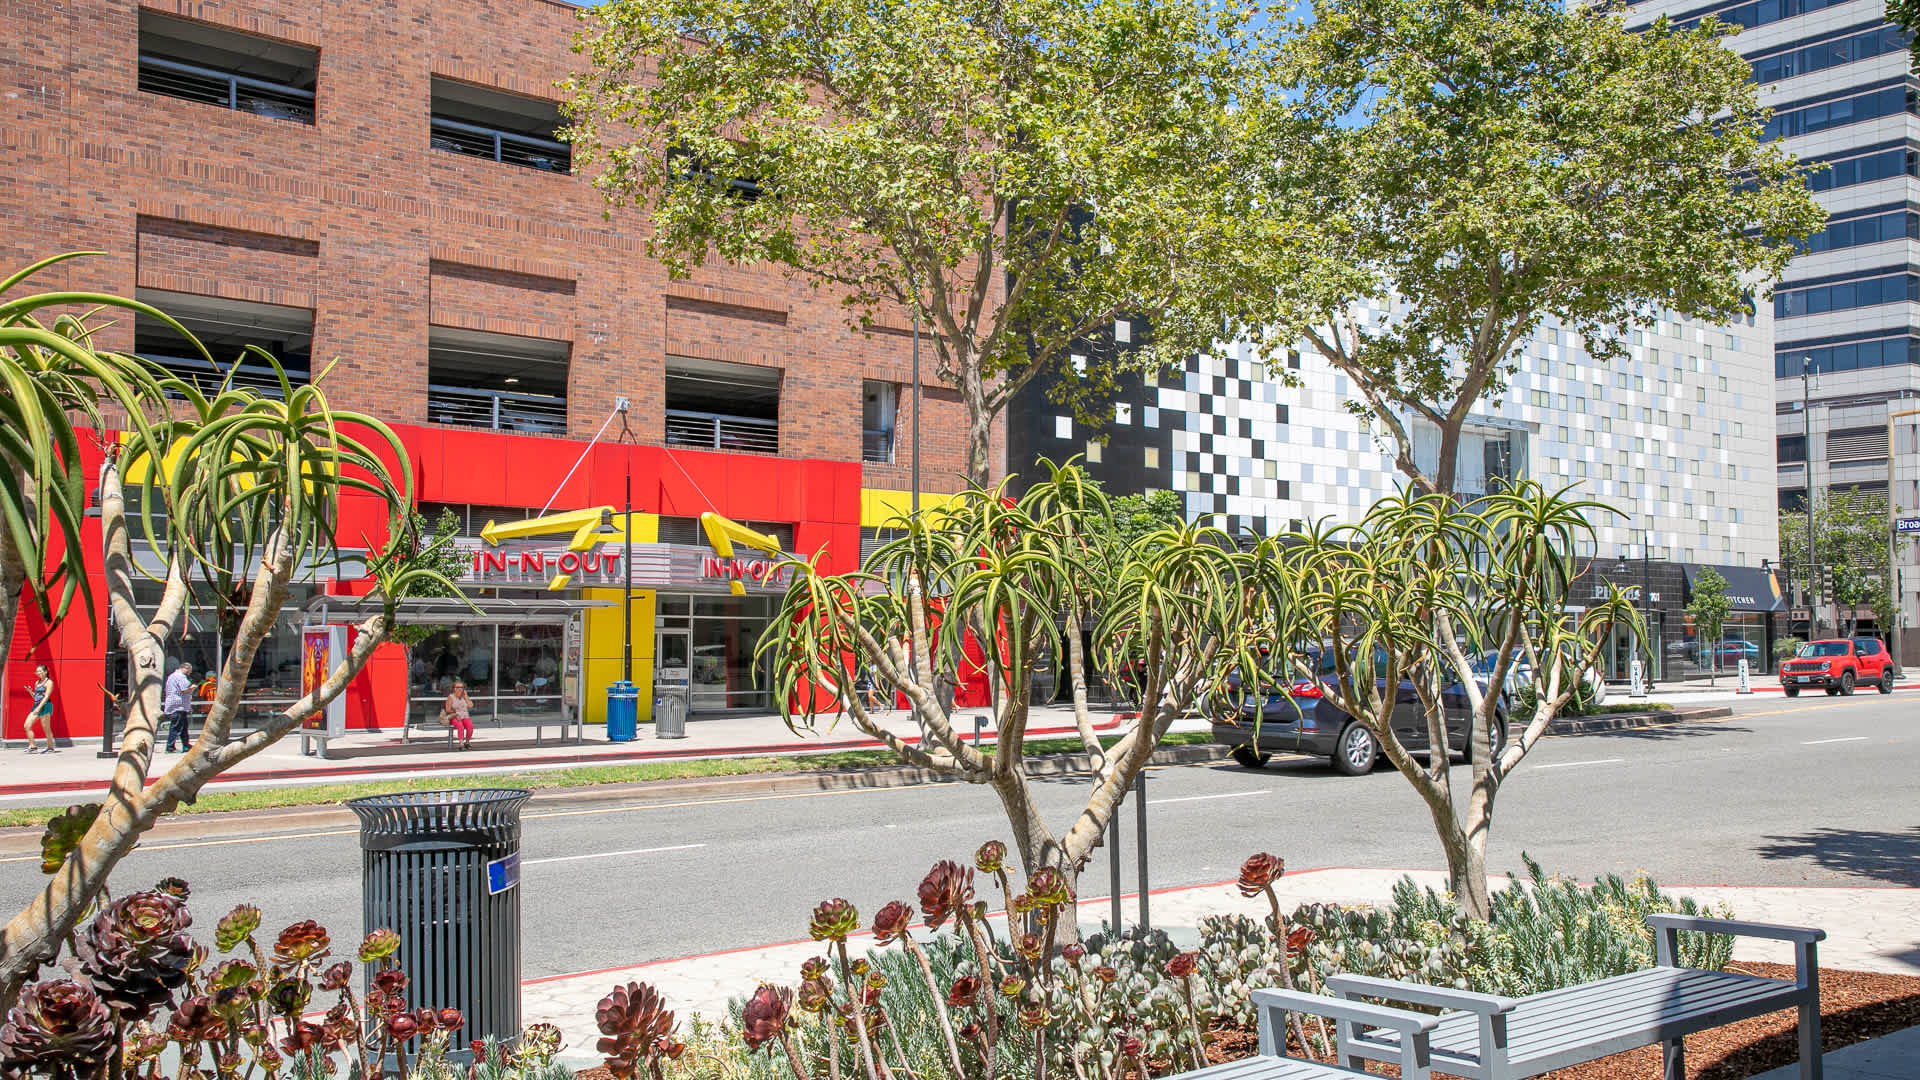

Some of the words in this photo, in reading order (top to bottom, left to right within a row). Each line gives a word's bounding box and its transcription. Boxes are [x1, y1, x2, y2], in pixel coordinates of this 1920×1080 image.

[1898, 520, 1920, 529] Broa
[473, 550, 621, 574] IN-N-OUT
[702, 556, 785, 582] IN-N-OUT
